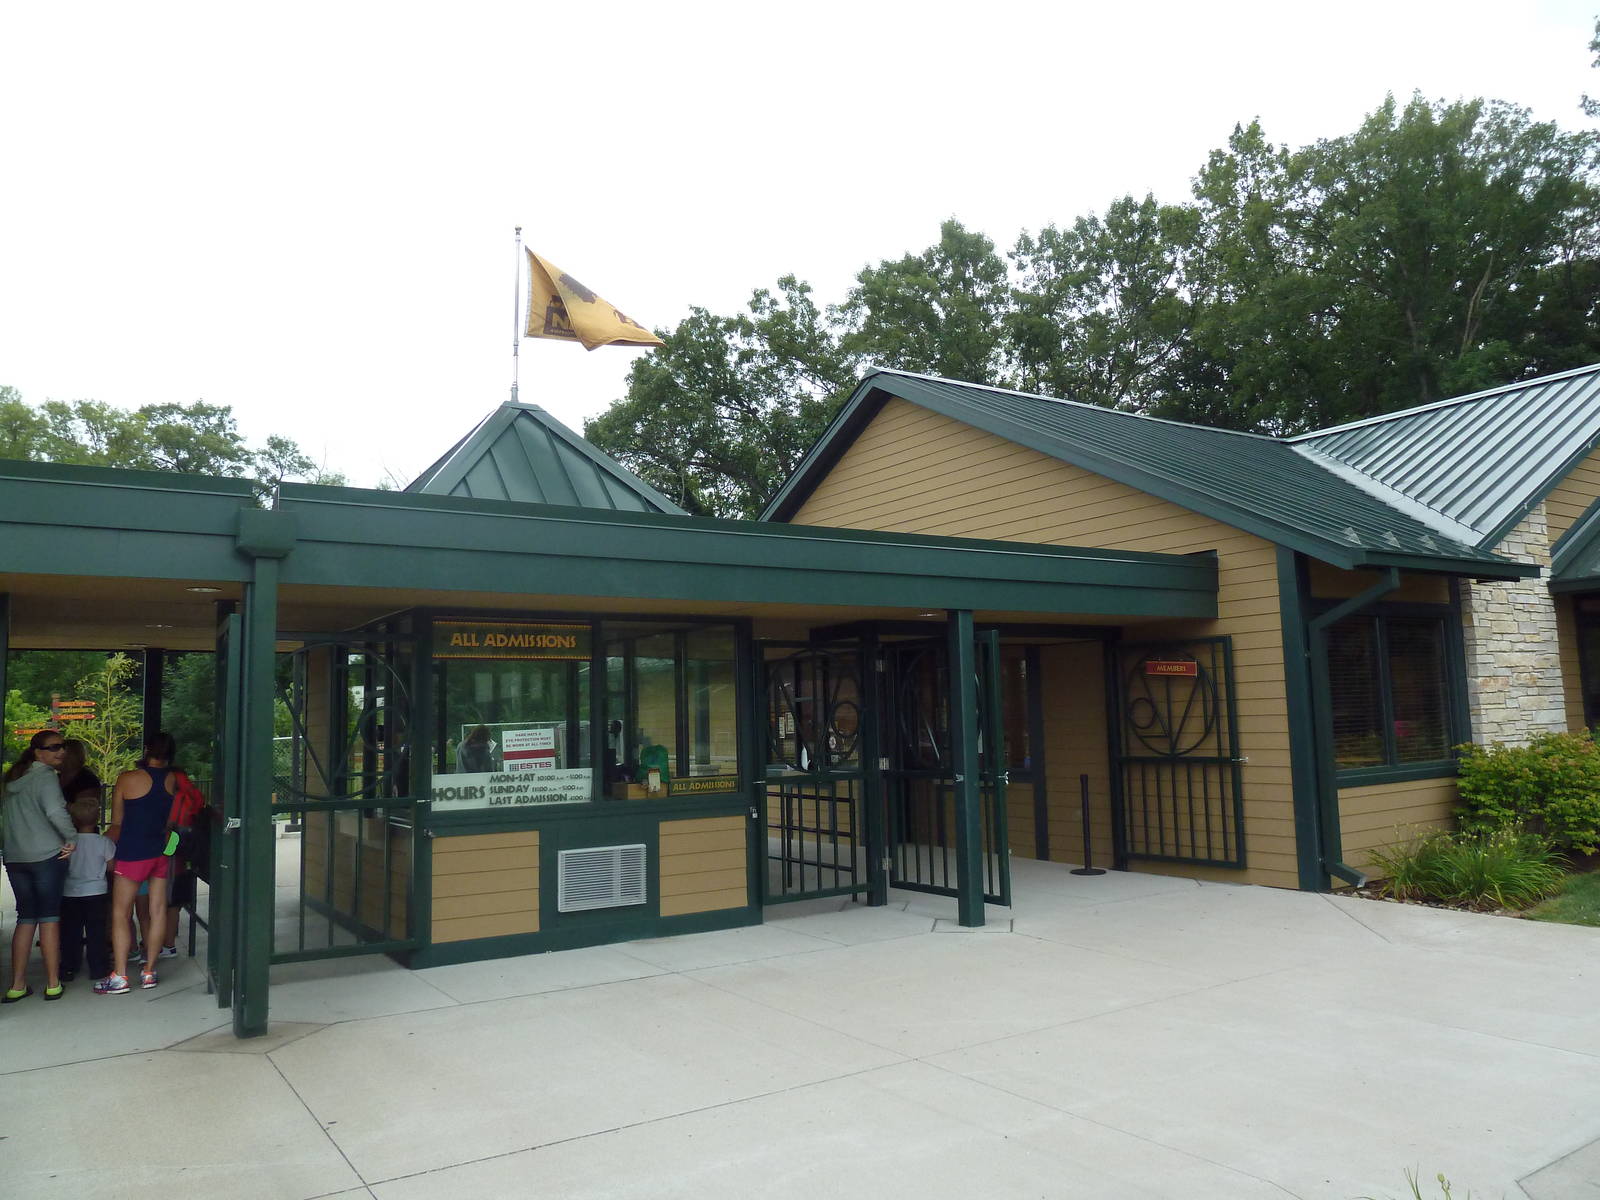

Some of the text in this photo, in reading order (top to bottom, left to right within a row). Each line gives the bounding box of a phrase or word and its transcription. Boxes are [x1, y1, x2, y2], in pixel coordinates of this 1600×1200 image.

[450, 632, 577, 648] ALL ADMISSIONS
[489, 773, 535, 783] MON-SAT
[489, 784, 530, 794] SUNDAY
[673, 781, 736, 792] ALL ADMISSIONS
[432, 785, 486, 802] HOURS
[489, 795, 513, 805] LAST
[514, 793, 567, 804] ADMISSION
